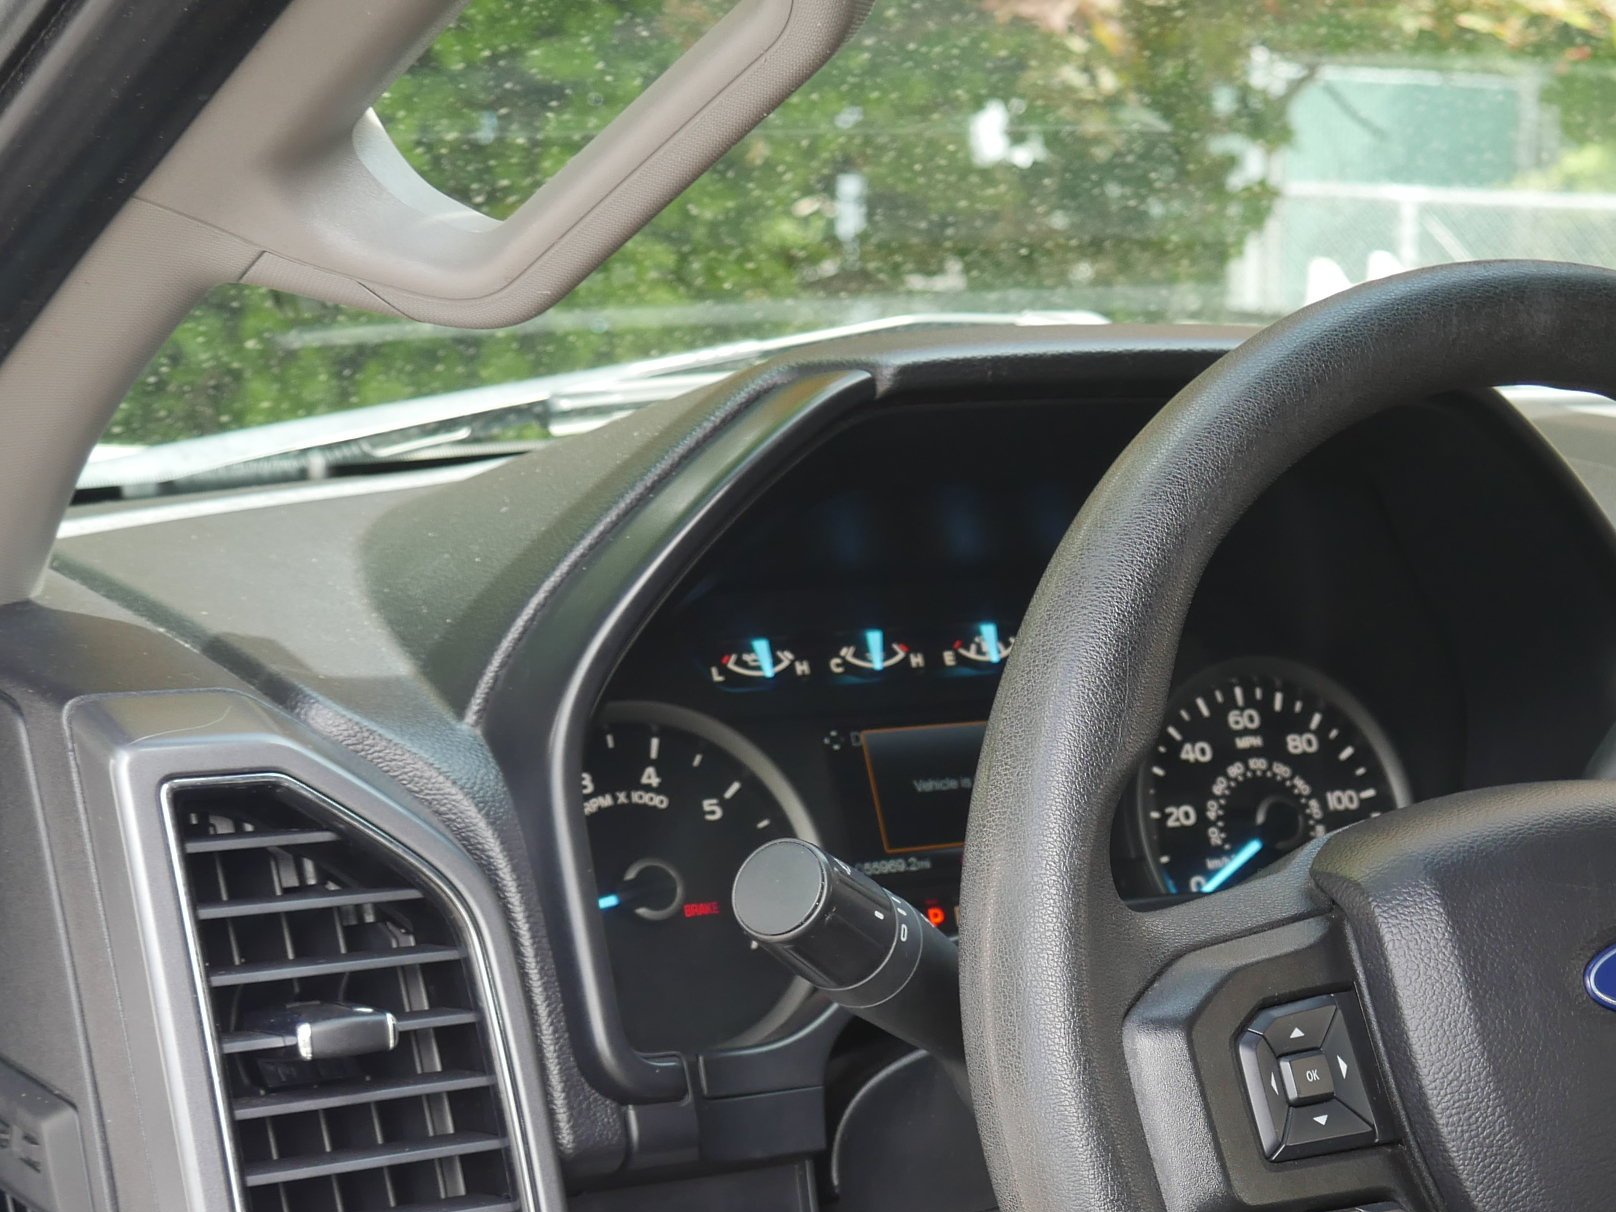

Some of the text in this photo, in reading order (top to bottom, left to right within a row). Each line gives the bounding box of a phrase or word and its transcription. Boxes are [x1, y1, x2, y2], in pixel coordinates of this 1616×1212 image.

[795, 659, 811, 676] H
[829, 657, 844, 674] C
[909, 652, 925, 668] H
[943, 651, 956, 667] E
[711, 667, 724, 683] L
[1227, 708, 1261, 731] 60
[1179, 741, 1213, 763] 40
[1235, 735, 1263, 749] MPH
[1285, 733, 1319, 755] 80
[1247, 757, 1268, 771] 100
[581, 772, 594, 794] 3
[640, 766, 661, 788] 4
[913, 777, 958, 793] Vehicle
[584, 793, 613, 816] RPM
[631, 790, 669, 810] 1000
[702, 798, 723, 821] 5
[1206, 799, 1219, 821] 40
[1325, 789, 1360, 811] 100
[1164, 804, 1197, 828] 20
[683, 901, 720, 919] BRAKE
[1306, 1068, 1320, 1082] OK
